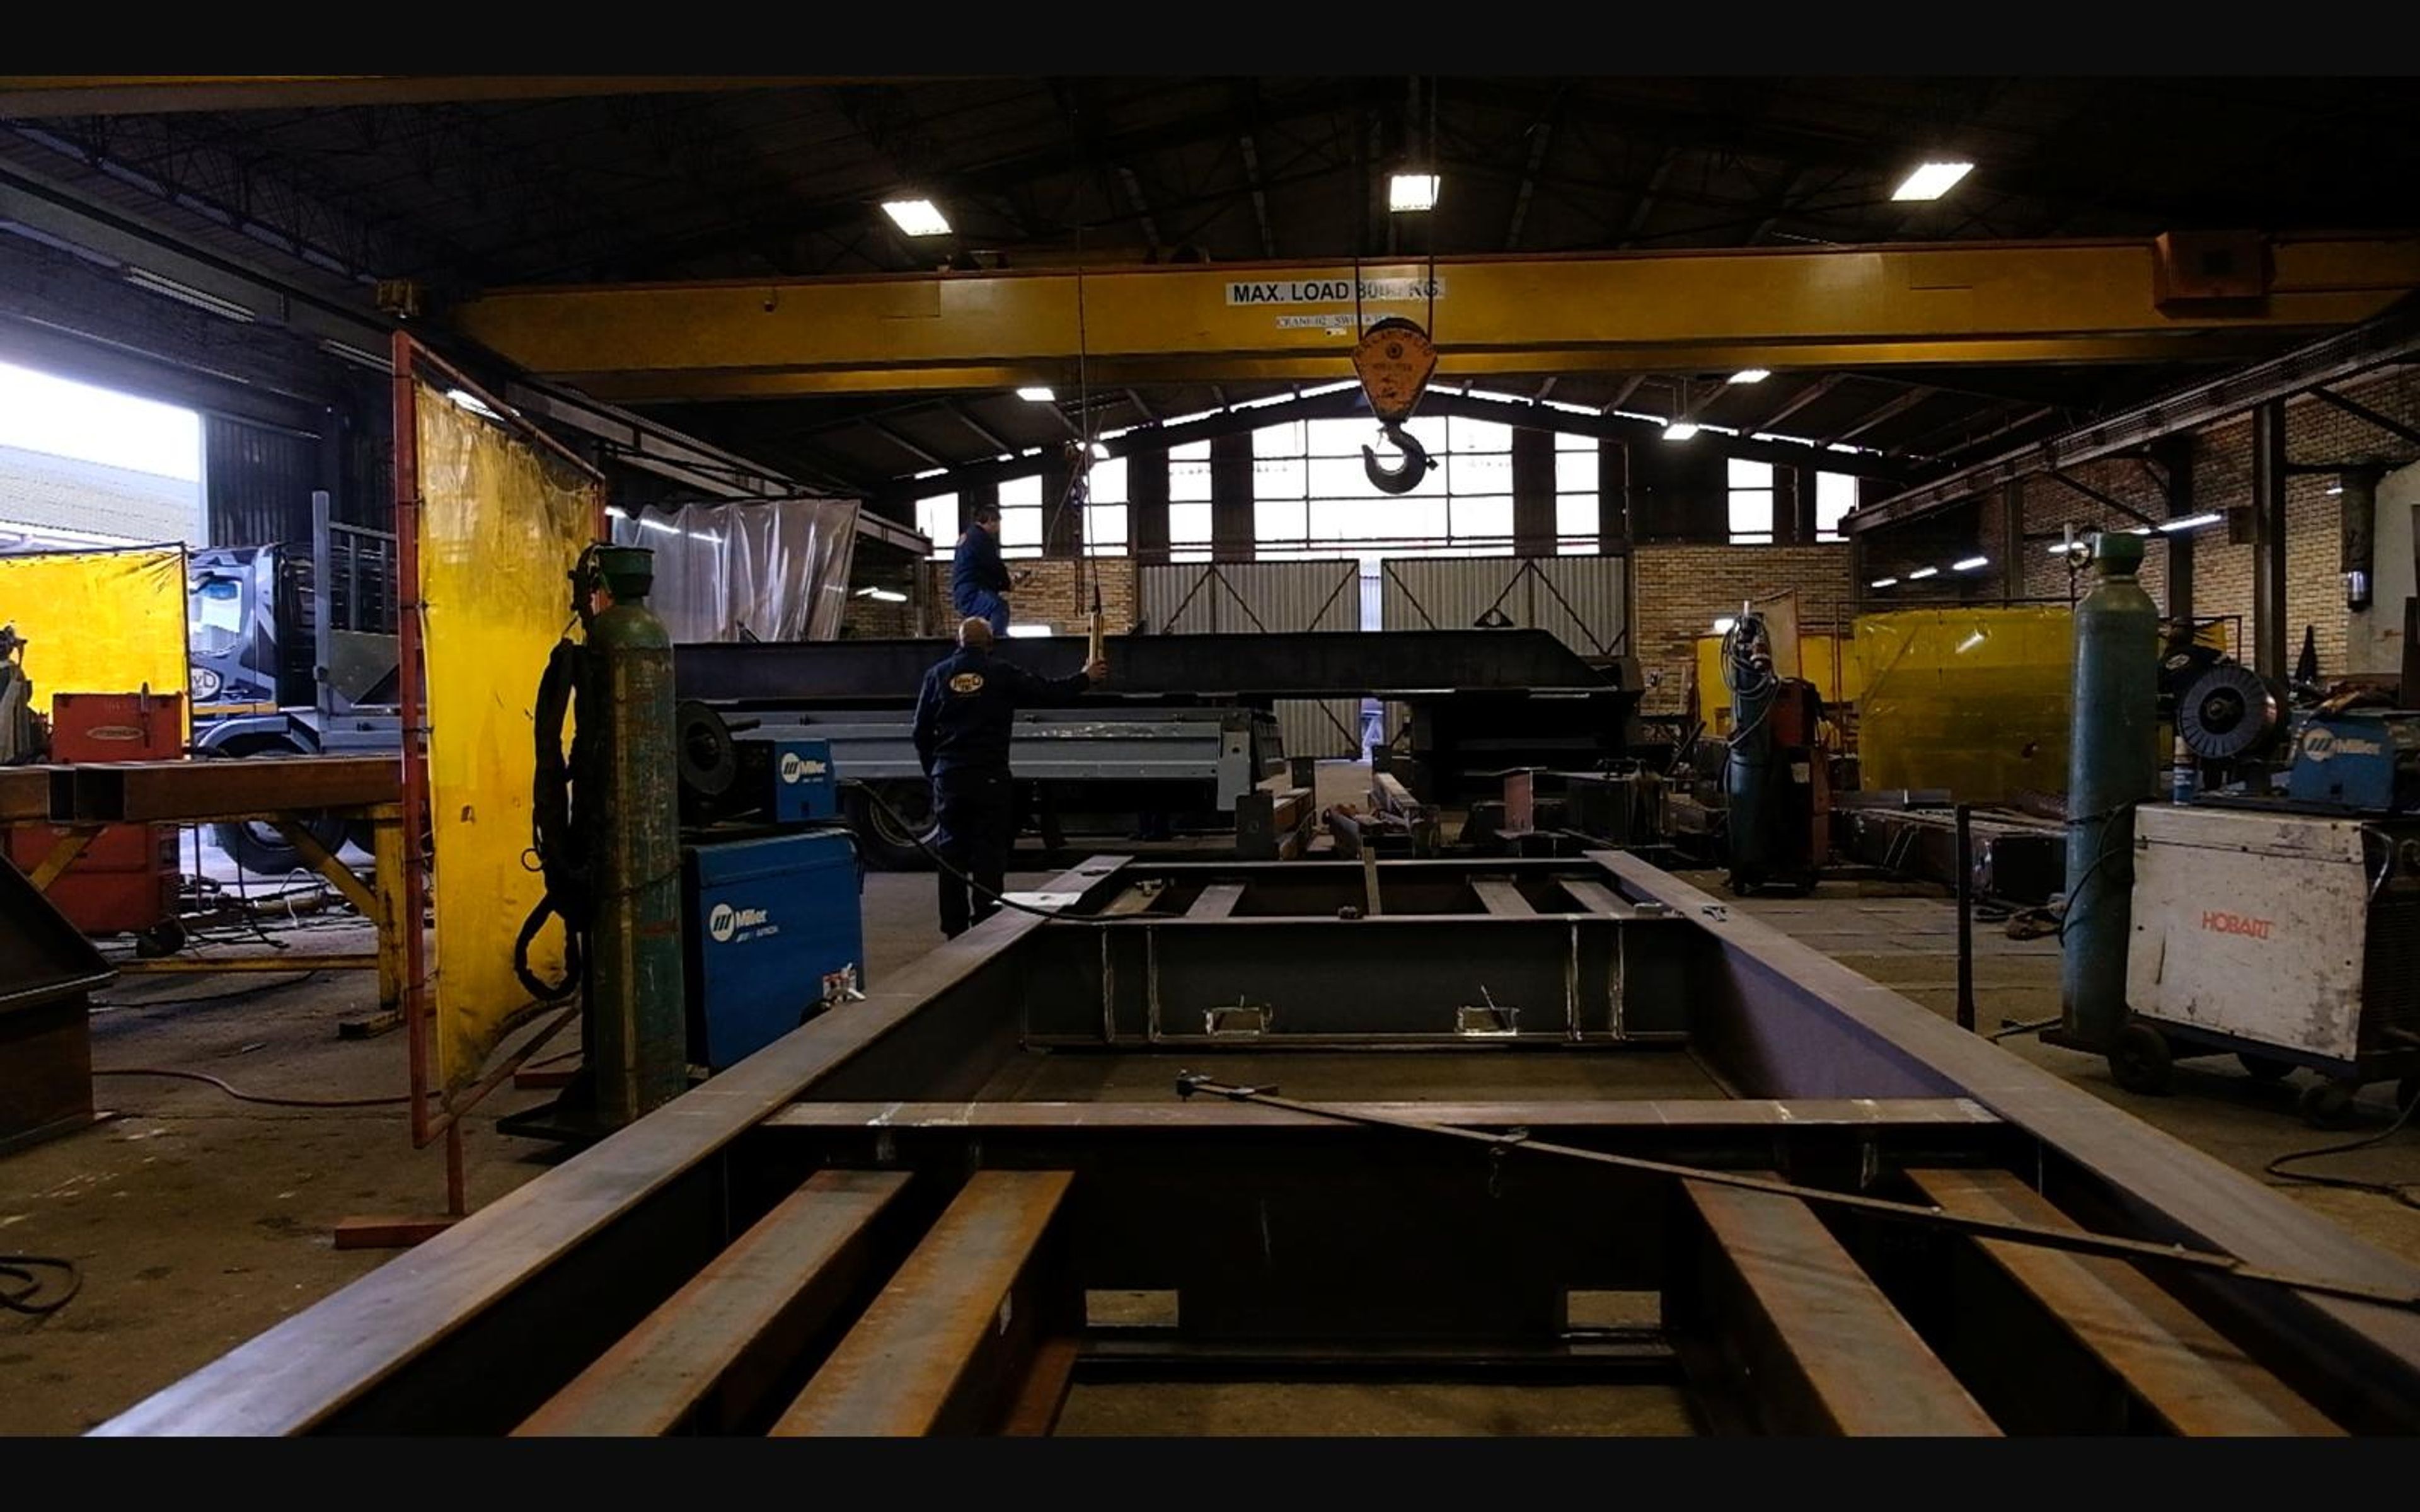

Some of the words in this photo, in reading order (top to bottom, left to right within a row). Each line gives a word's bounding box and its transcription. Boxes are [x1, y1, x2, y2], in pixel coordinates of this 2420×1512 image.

[1234, 285, 1283, 302] MAX.
[1291, 282, 1349, 301] LOAD
[735, 908, 768, 928] Miller
[2201, 910, 2276, 940] HOBART
